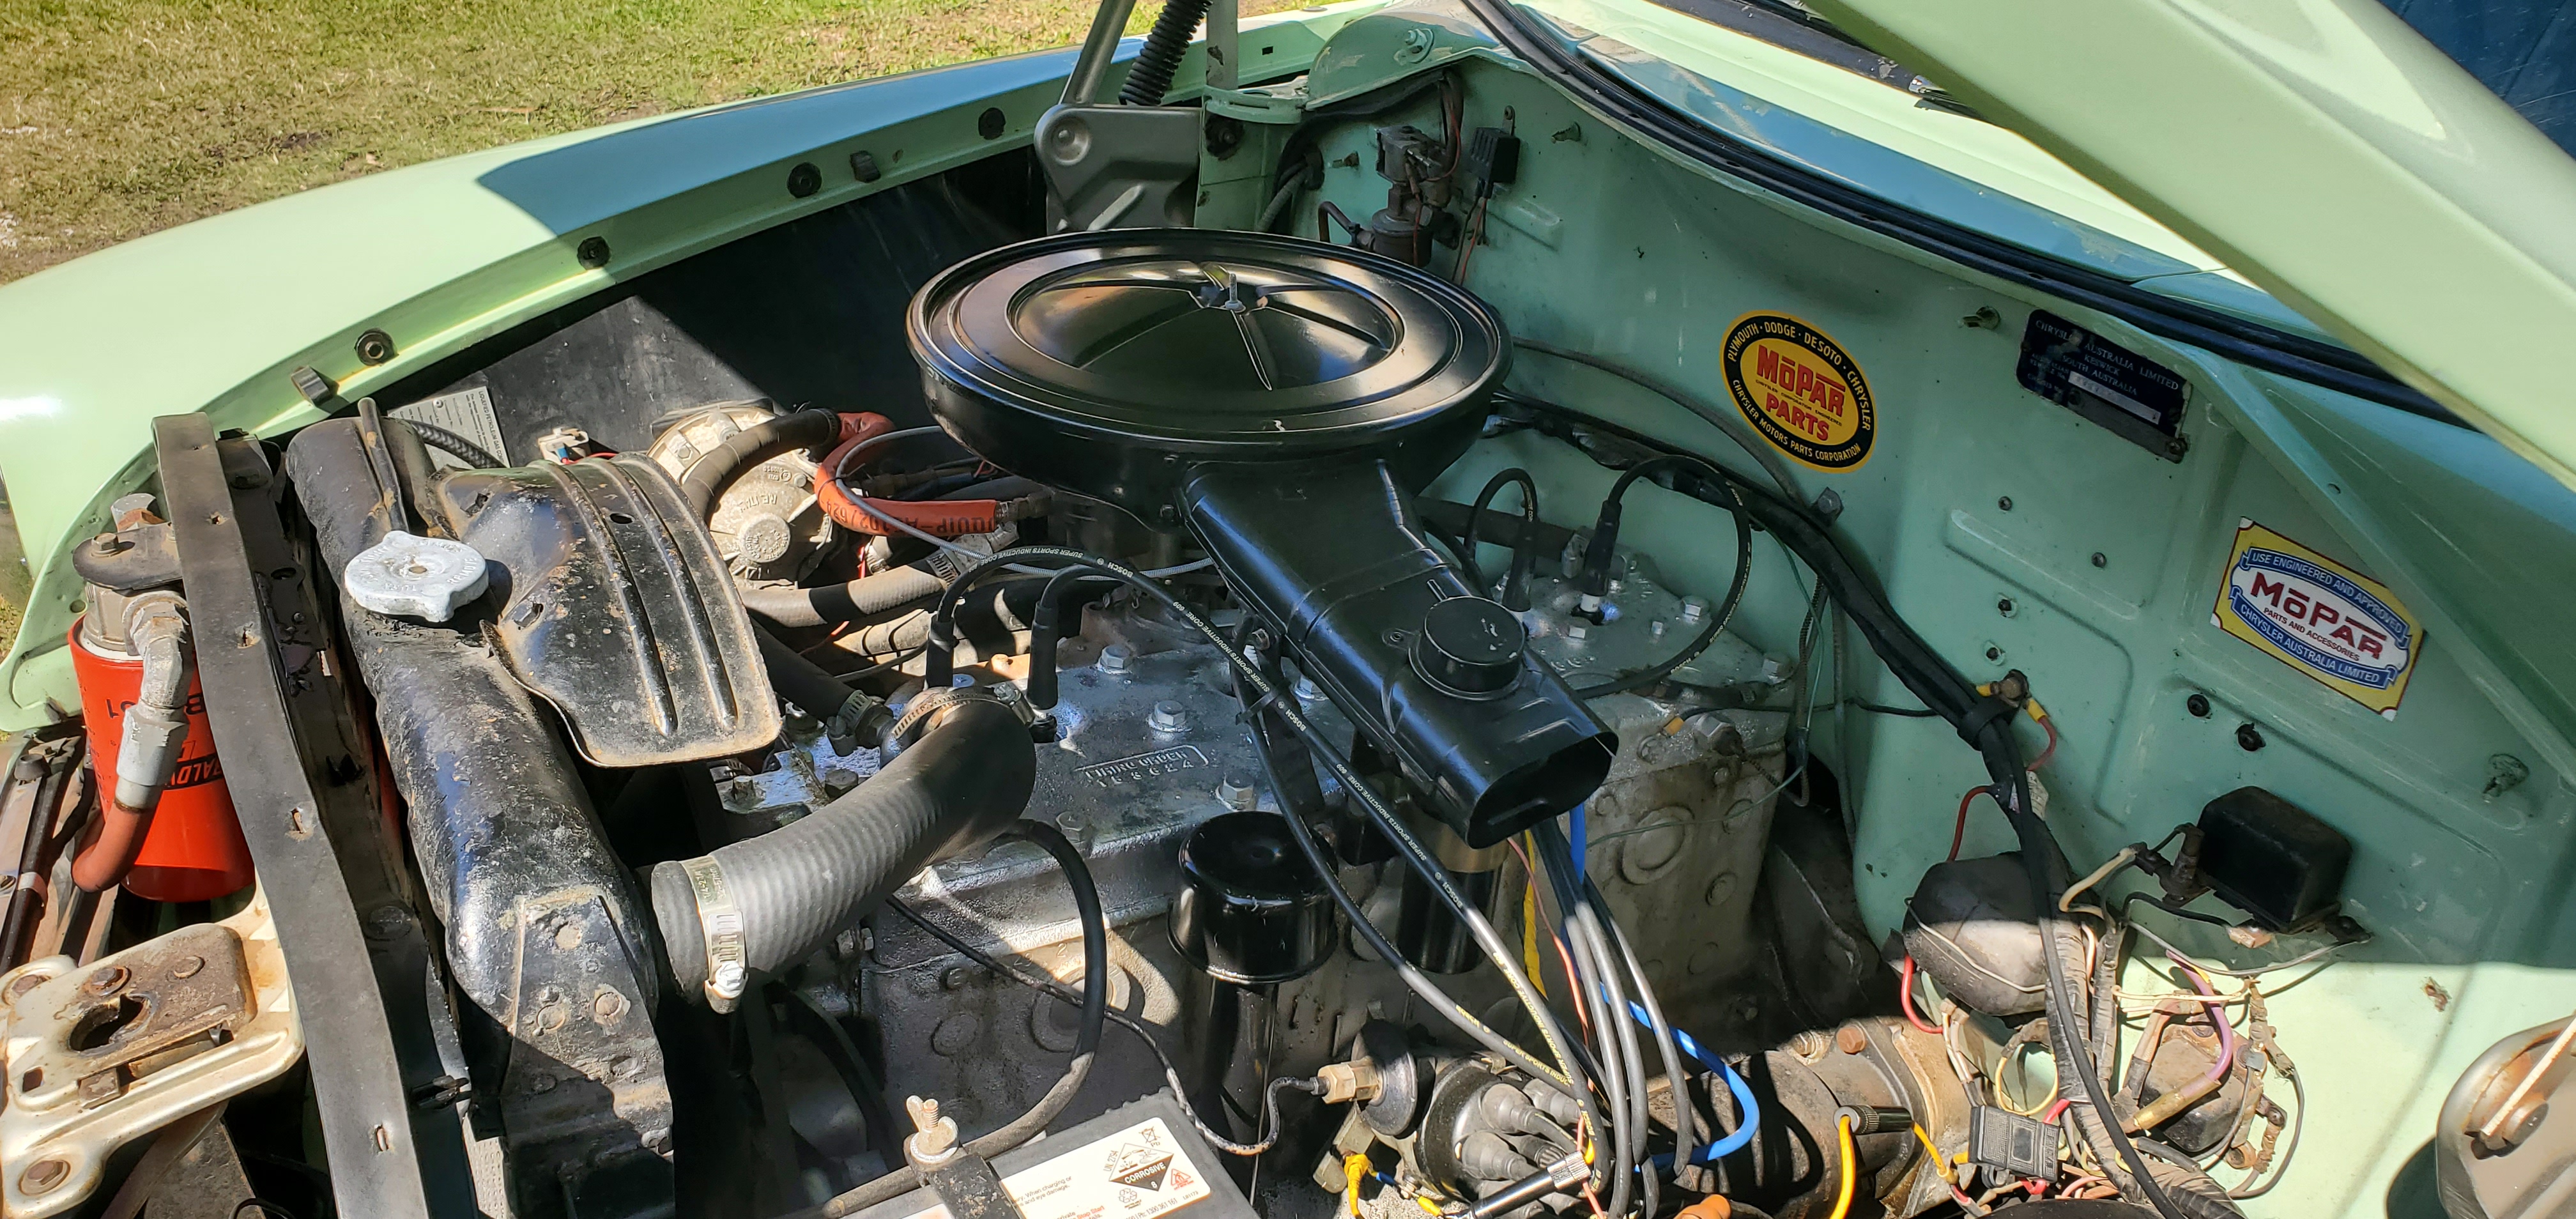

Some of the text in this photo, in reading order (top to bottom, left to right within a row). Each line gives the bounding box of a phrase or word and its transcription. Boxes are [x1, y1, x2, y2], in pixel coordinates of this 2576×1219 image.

[1728, 321, 1871, 431] PLYMOUTH DODGE DESOTO CHRYSLER
[2062, 355, 2089, 373] SOUTH
[2091, 369, 2138, 396] AUSTRALIA
[2084, 354, 2121, 377] KESWICK
[2084, 342, 2135, 372] AUSTRALIA
[2138, 367, 2179, 391] LIMITED
[1732, 379, 1861, 461] CHRYSLER MOTORS PARTS CORPORATION
[1765, 392, 1829, 441] PARTS
[980, 554, 997, 567] CORE
[997, 548, 1031, 560] INDUCTIVE
[1060, 548, 1084, 559] SUPER
[1107, 562, 1134, 579] BOSCH
[2252, 551, 2403, 634] USE ENGINEERED AND APPROVED
[2240, 604, 2380, 683] CHRYSLER AUSTRALIA LIMITED
[2262, 607, 2360, 661] PARTS AND ACCESSORIES
[1172, 601, 1307, 732] BOSCH SUPER SPORTS INDUCTIVE CORE 609
[1336, 763, 1464, 909] BOSCH SUPER SPORTS INDUCTIVE CORE 609
[1518, 989, 1545, 1031] INDUCTIVE
[1503, 1039, 1526, 1059] SUPER
[1525, 1054, 1551, 1074] SPORTS
[1541, 1027, 1562, 1059] SPORTS
[1042, 1179, 1066, 1192] charging
[1124, 1161, 1167, 1184] CORROSIVE
